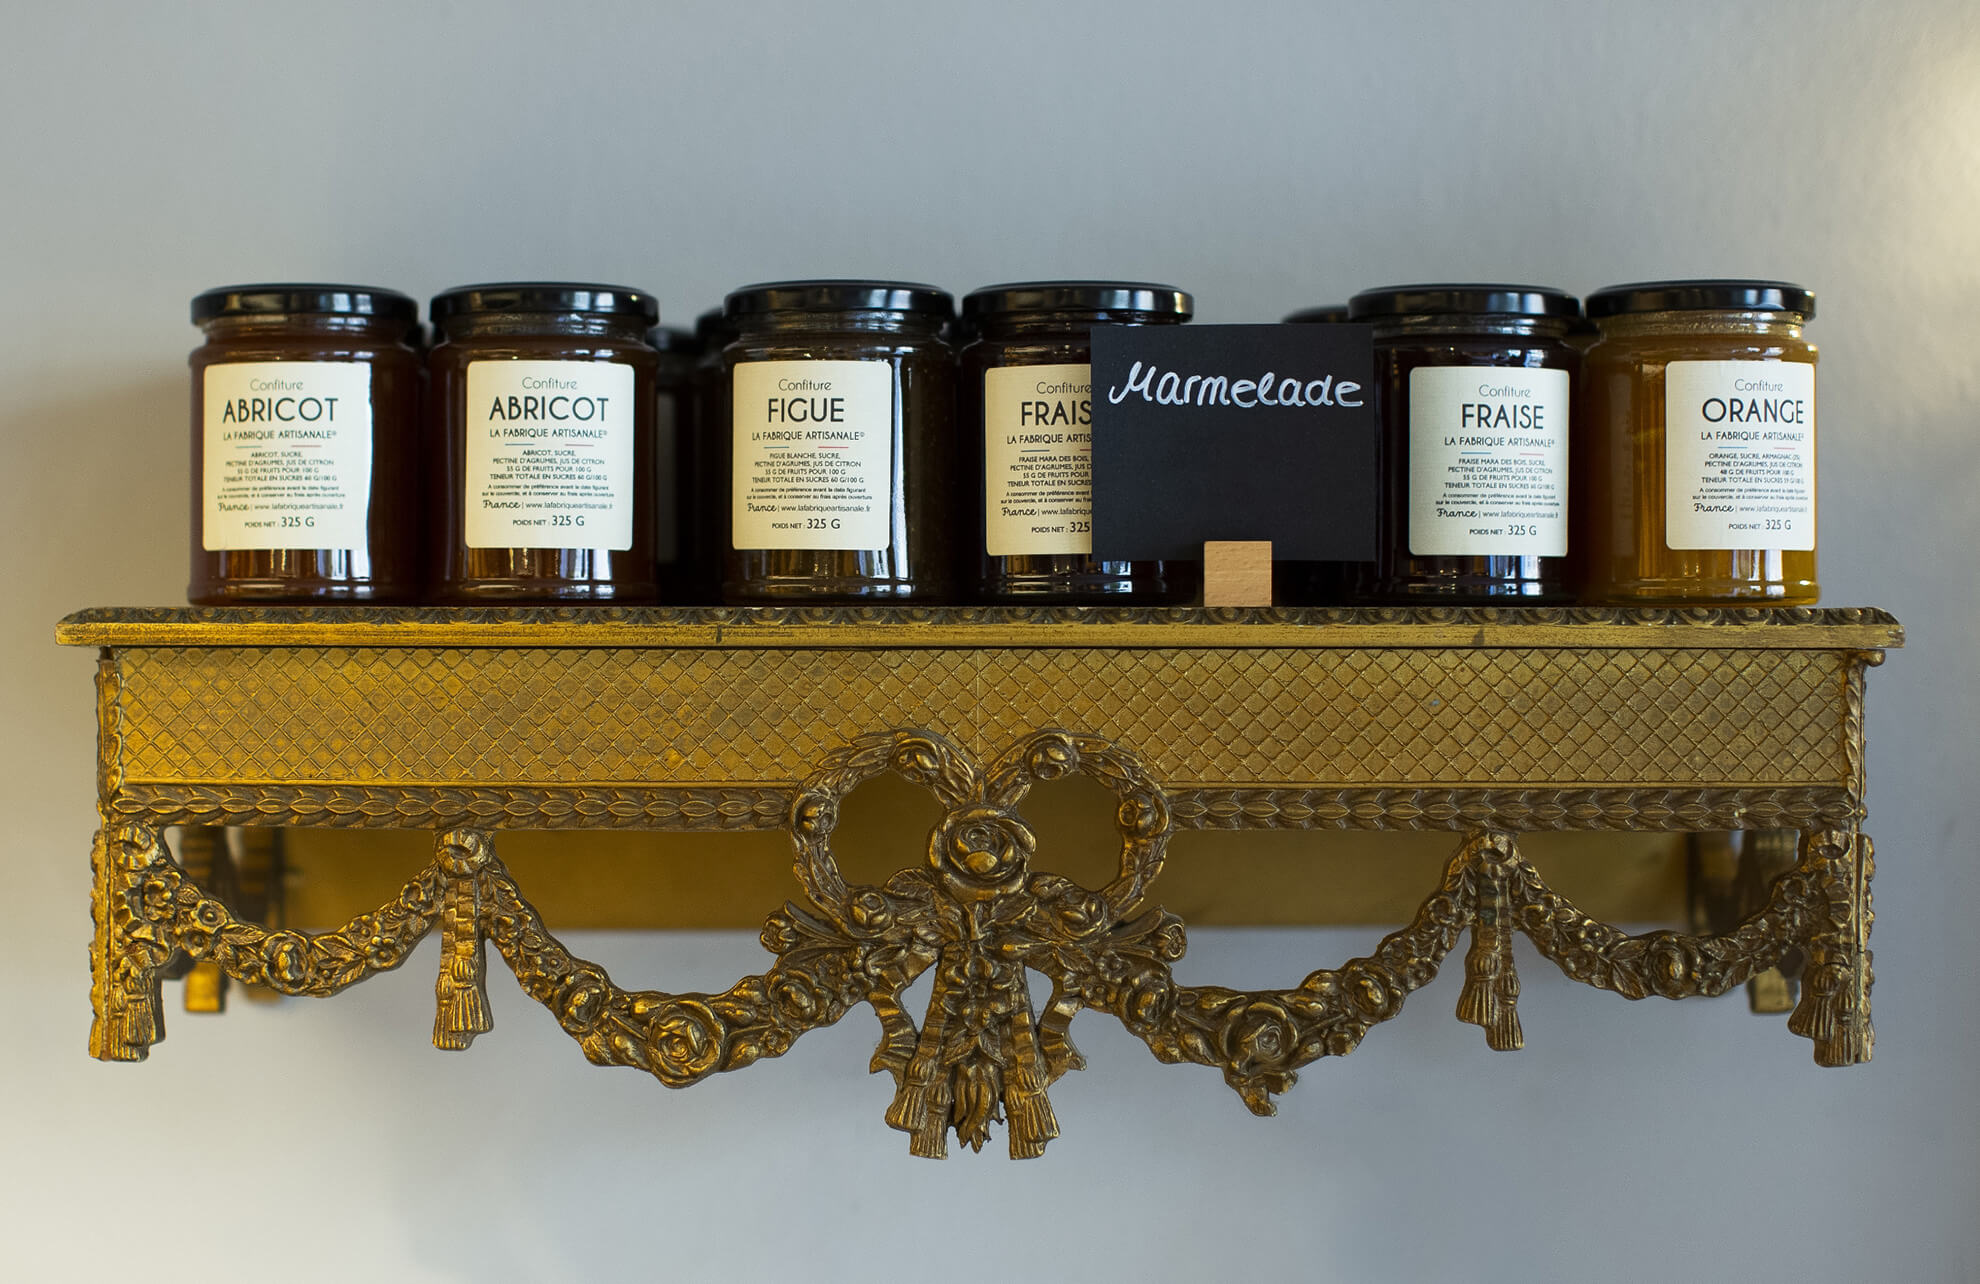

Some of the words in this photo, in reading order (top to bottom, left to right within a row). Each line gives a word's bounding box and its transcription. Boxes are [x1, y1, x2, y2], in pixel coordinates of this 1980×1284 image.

[250, 379, 303, 391] Confiture
[522, 377, 577, 390] Confiture
[779, 379, 831, 391] Confiture
[1037, 382, 1091, 394] Confiture
[1108, 361, 1363, 408] Marmelade
[1735, 379, 1783, 392] Confiture
[1479, 384, 1530, 397] Confiture
[223, 398, 339, 423] ABRICOT
[489, 396, 608, 421] ABRICOT
[768, 398, 844, 422] FIGUE
[1022, 400, 1091, 426] FRAIS
[1702, 398, 1803, 424] ORANGE
[1462, 404, 1544, 429] FRAISE
[224, 432, 232, 441] LA
[234, 431, 274, 440] FABRIQUE
[490, 429, 500, 438] LA
[504, 428, 548, 438] FABRIQUE
[763, 431, 802, 440] FABRIQUE
[1701, 432, 1712, 440] LA
[1716, 431, 1759, 441] FABRIQUE
[1007, 436, 1016, 444] LA
[1020, 434, 1062, 443] FABRIQUE
[1445, 437, 1456, 446] LA
[1460, 437, 1504, 446] FABRIQUE
[219, 503, 249, 511] France
[483, 500, 520, 509] France
[748, 503, 777, 512] France
[1694, 503, 1734, 512] France
[1001, 507, 1036, 516] France
[1436, 508, 1477, 518] France
[282, 517, 300, 527] 325
[305, 517, 314, 527] G
[552, 516, 571, 526] 325
[576, 516, 584, 526] G
[807, 519, 826, 529] 325
[831, 519, 840, 528] G
[1765, 520, 1781, 530] 325
[1785, 520, 1791, 529] G
[1070, 522, 1090, 532] 325
[1508, 525, 1526, 535] 325
[1529, 526, 1536, 535] G
